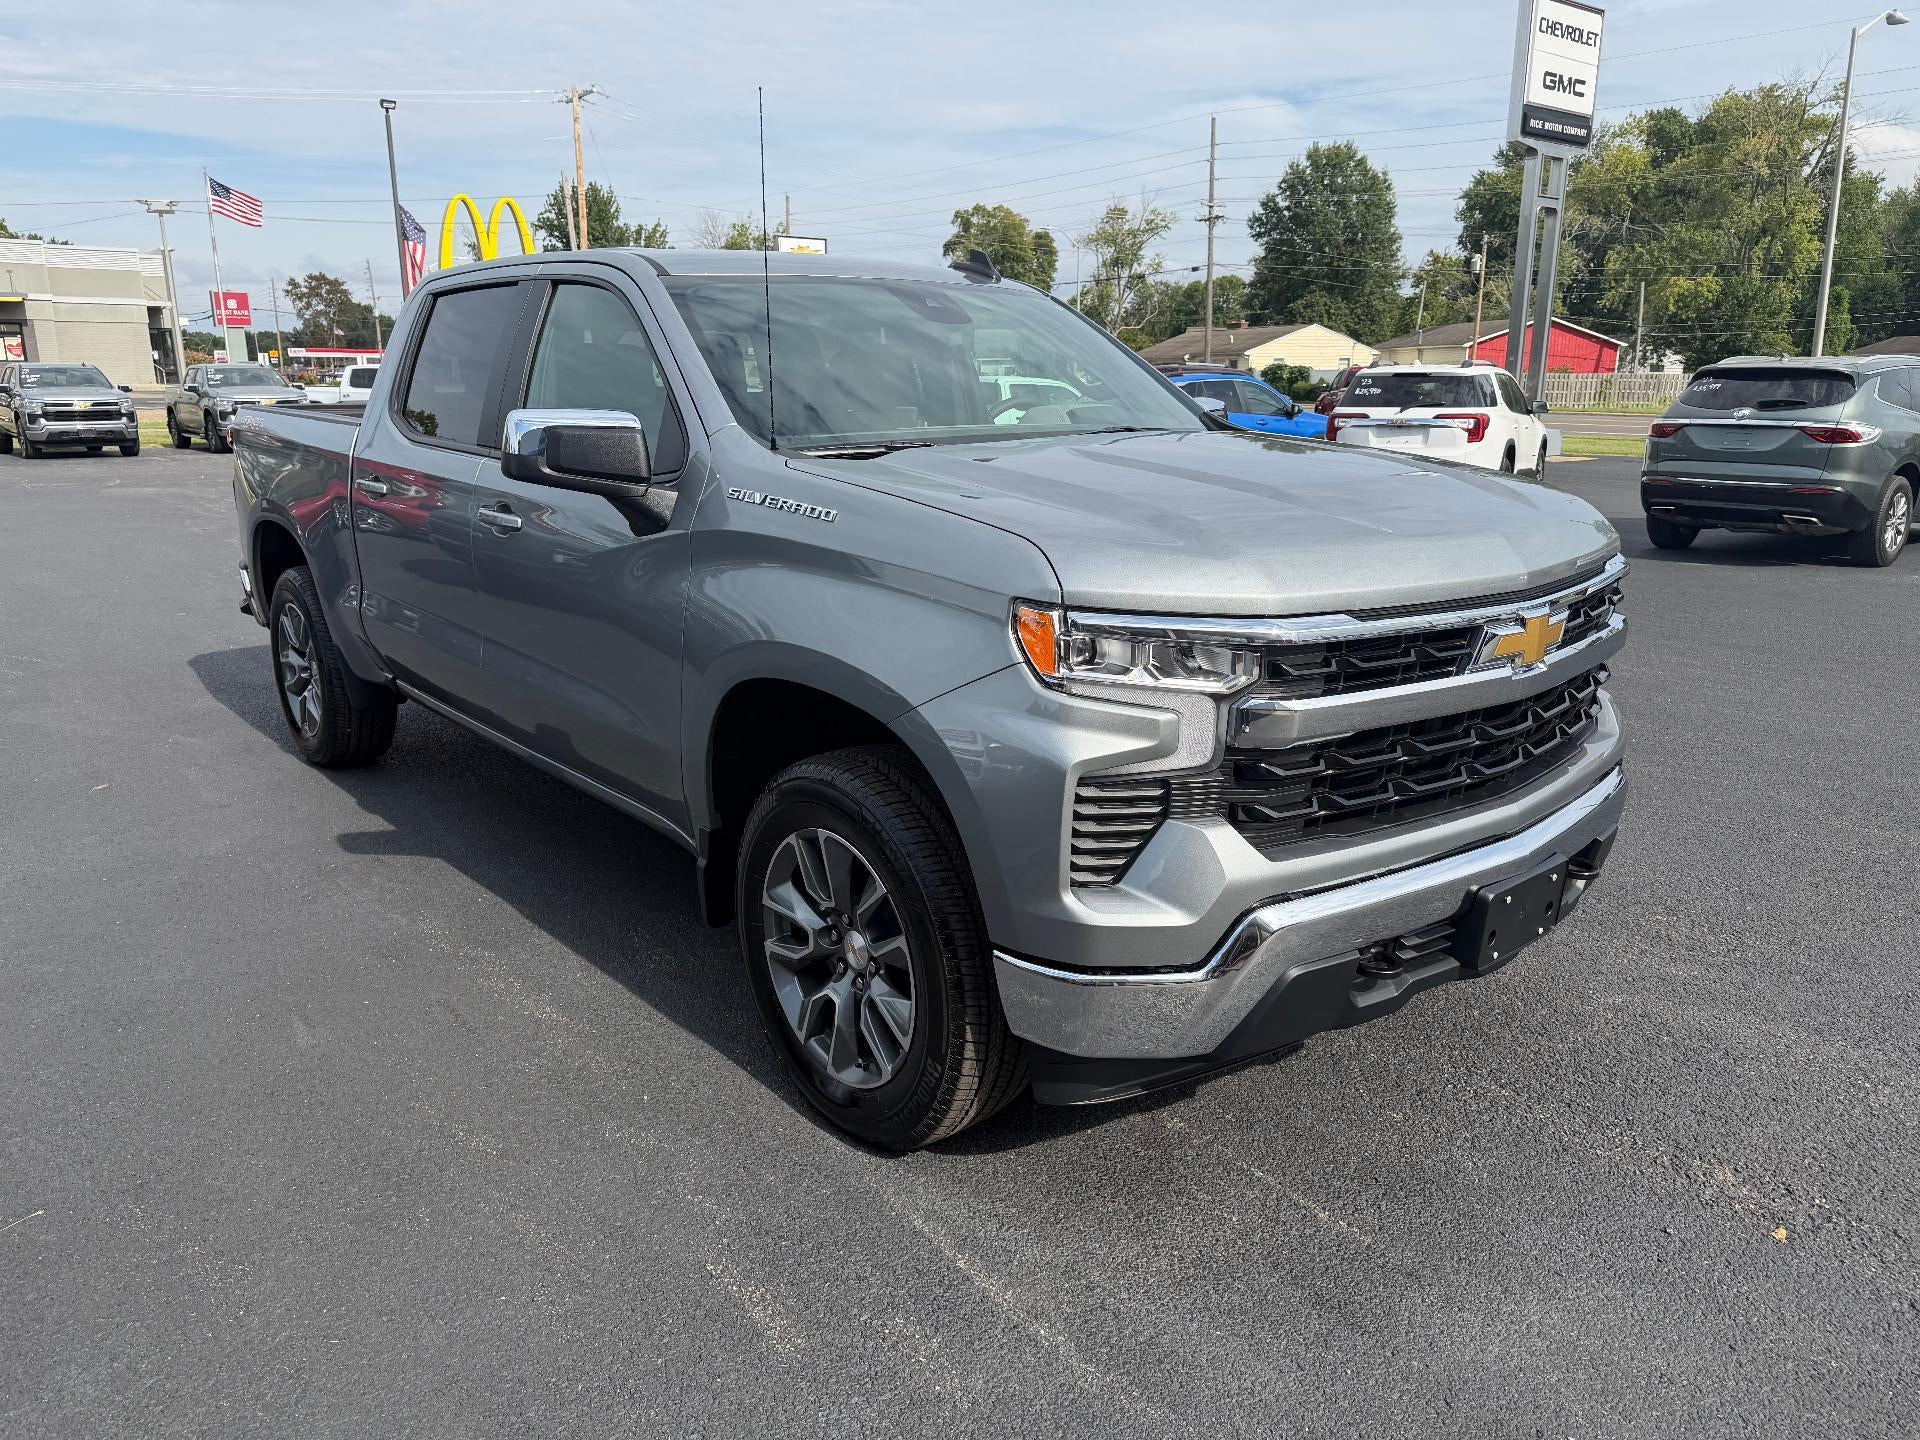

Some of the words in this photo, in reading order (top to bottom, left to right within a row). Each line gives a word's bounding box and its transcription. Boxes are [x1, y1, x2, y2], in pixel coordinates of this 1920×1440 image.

[1539, 17, 1599, 47] CHEVROLET
[1542, 70, 1587, 98] GMC
[1530, 118, 1543, 129] RICE
[1544, 121, 1562, 133] MOTOR
[1563, 125, 1588, 137] COMPANY
[726, 486, 838, 522] SILVERADO
